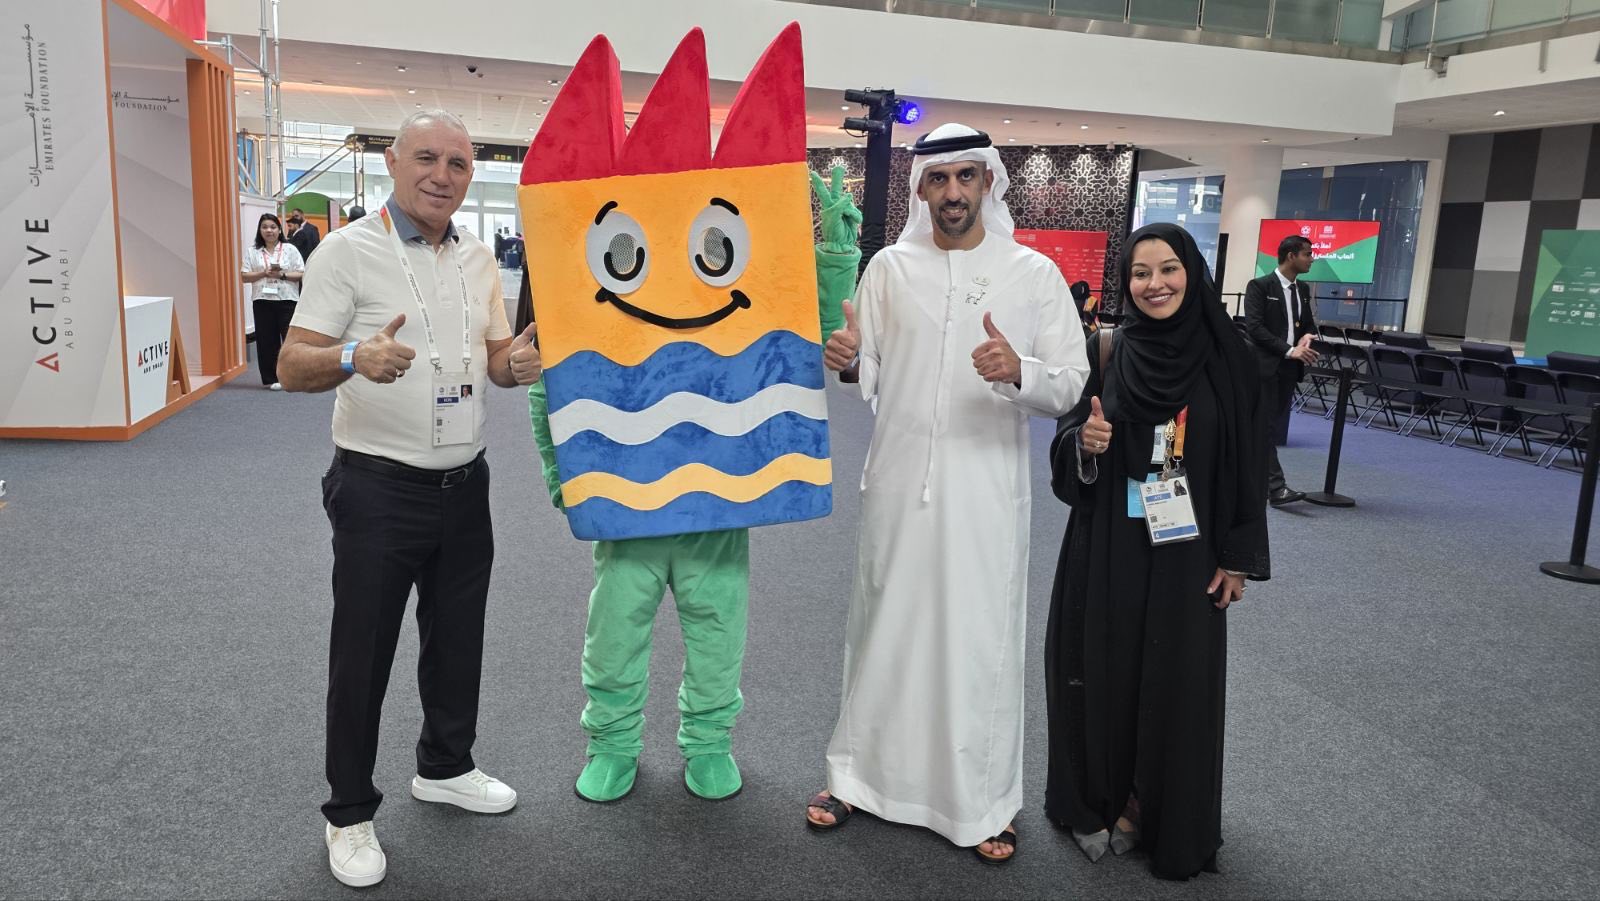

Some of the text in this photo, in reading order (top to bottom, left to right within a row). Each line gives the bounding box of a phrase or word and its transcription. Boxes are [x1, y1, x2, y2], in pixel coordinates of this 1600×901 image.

[37, 42, 54, 171] EMIRATES FOUNDATION
[115, 102, 167, 111] FOUNDATION
[25, 219, 60, 372] ACTIVE
[59, 249, 75, 349] ABU DHABI
[138, 340, 168, 367] ACTIVE
